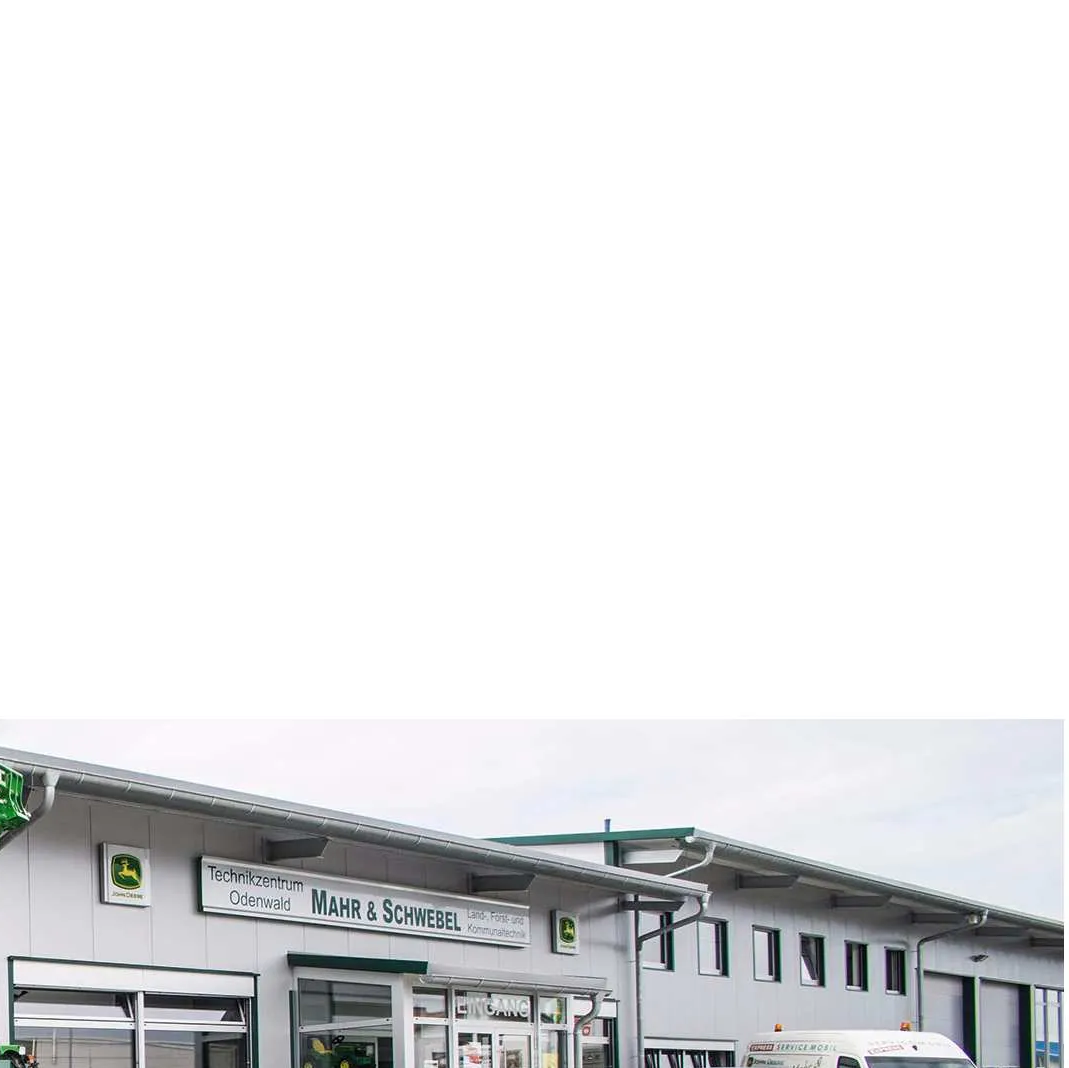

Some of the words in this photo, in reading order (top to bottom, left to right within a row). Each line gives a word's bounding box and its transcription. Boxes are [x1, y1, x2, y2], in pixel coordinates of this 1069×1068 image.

[207, 865, 304, 892] Technikzentrum
[229, 889, 291, 912] Odenwald
[311, 888, 362, 920] MAHR
[366, 901, 378, 922] &
[382, 898, 461, 932] SCHWEBEL
[457, 996, 530, 1018] EINGANG
